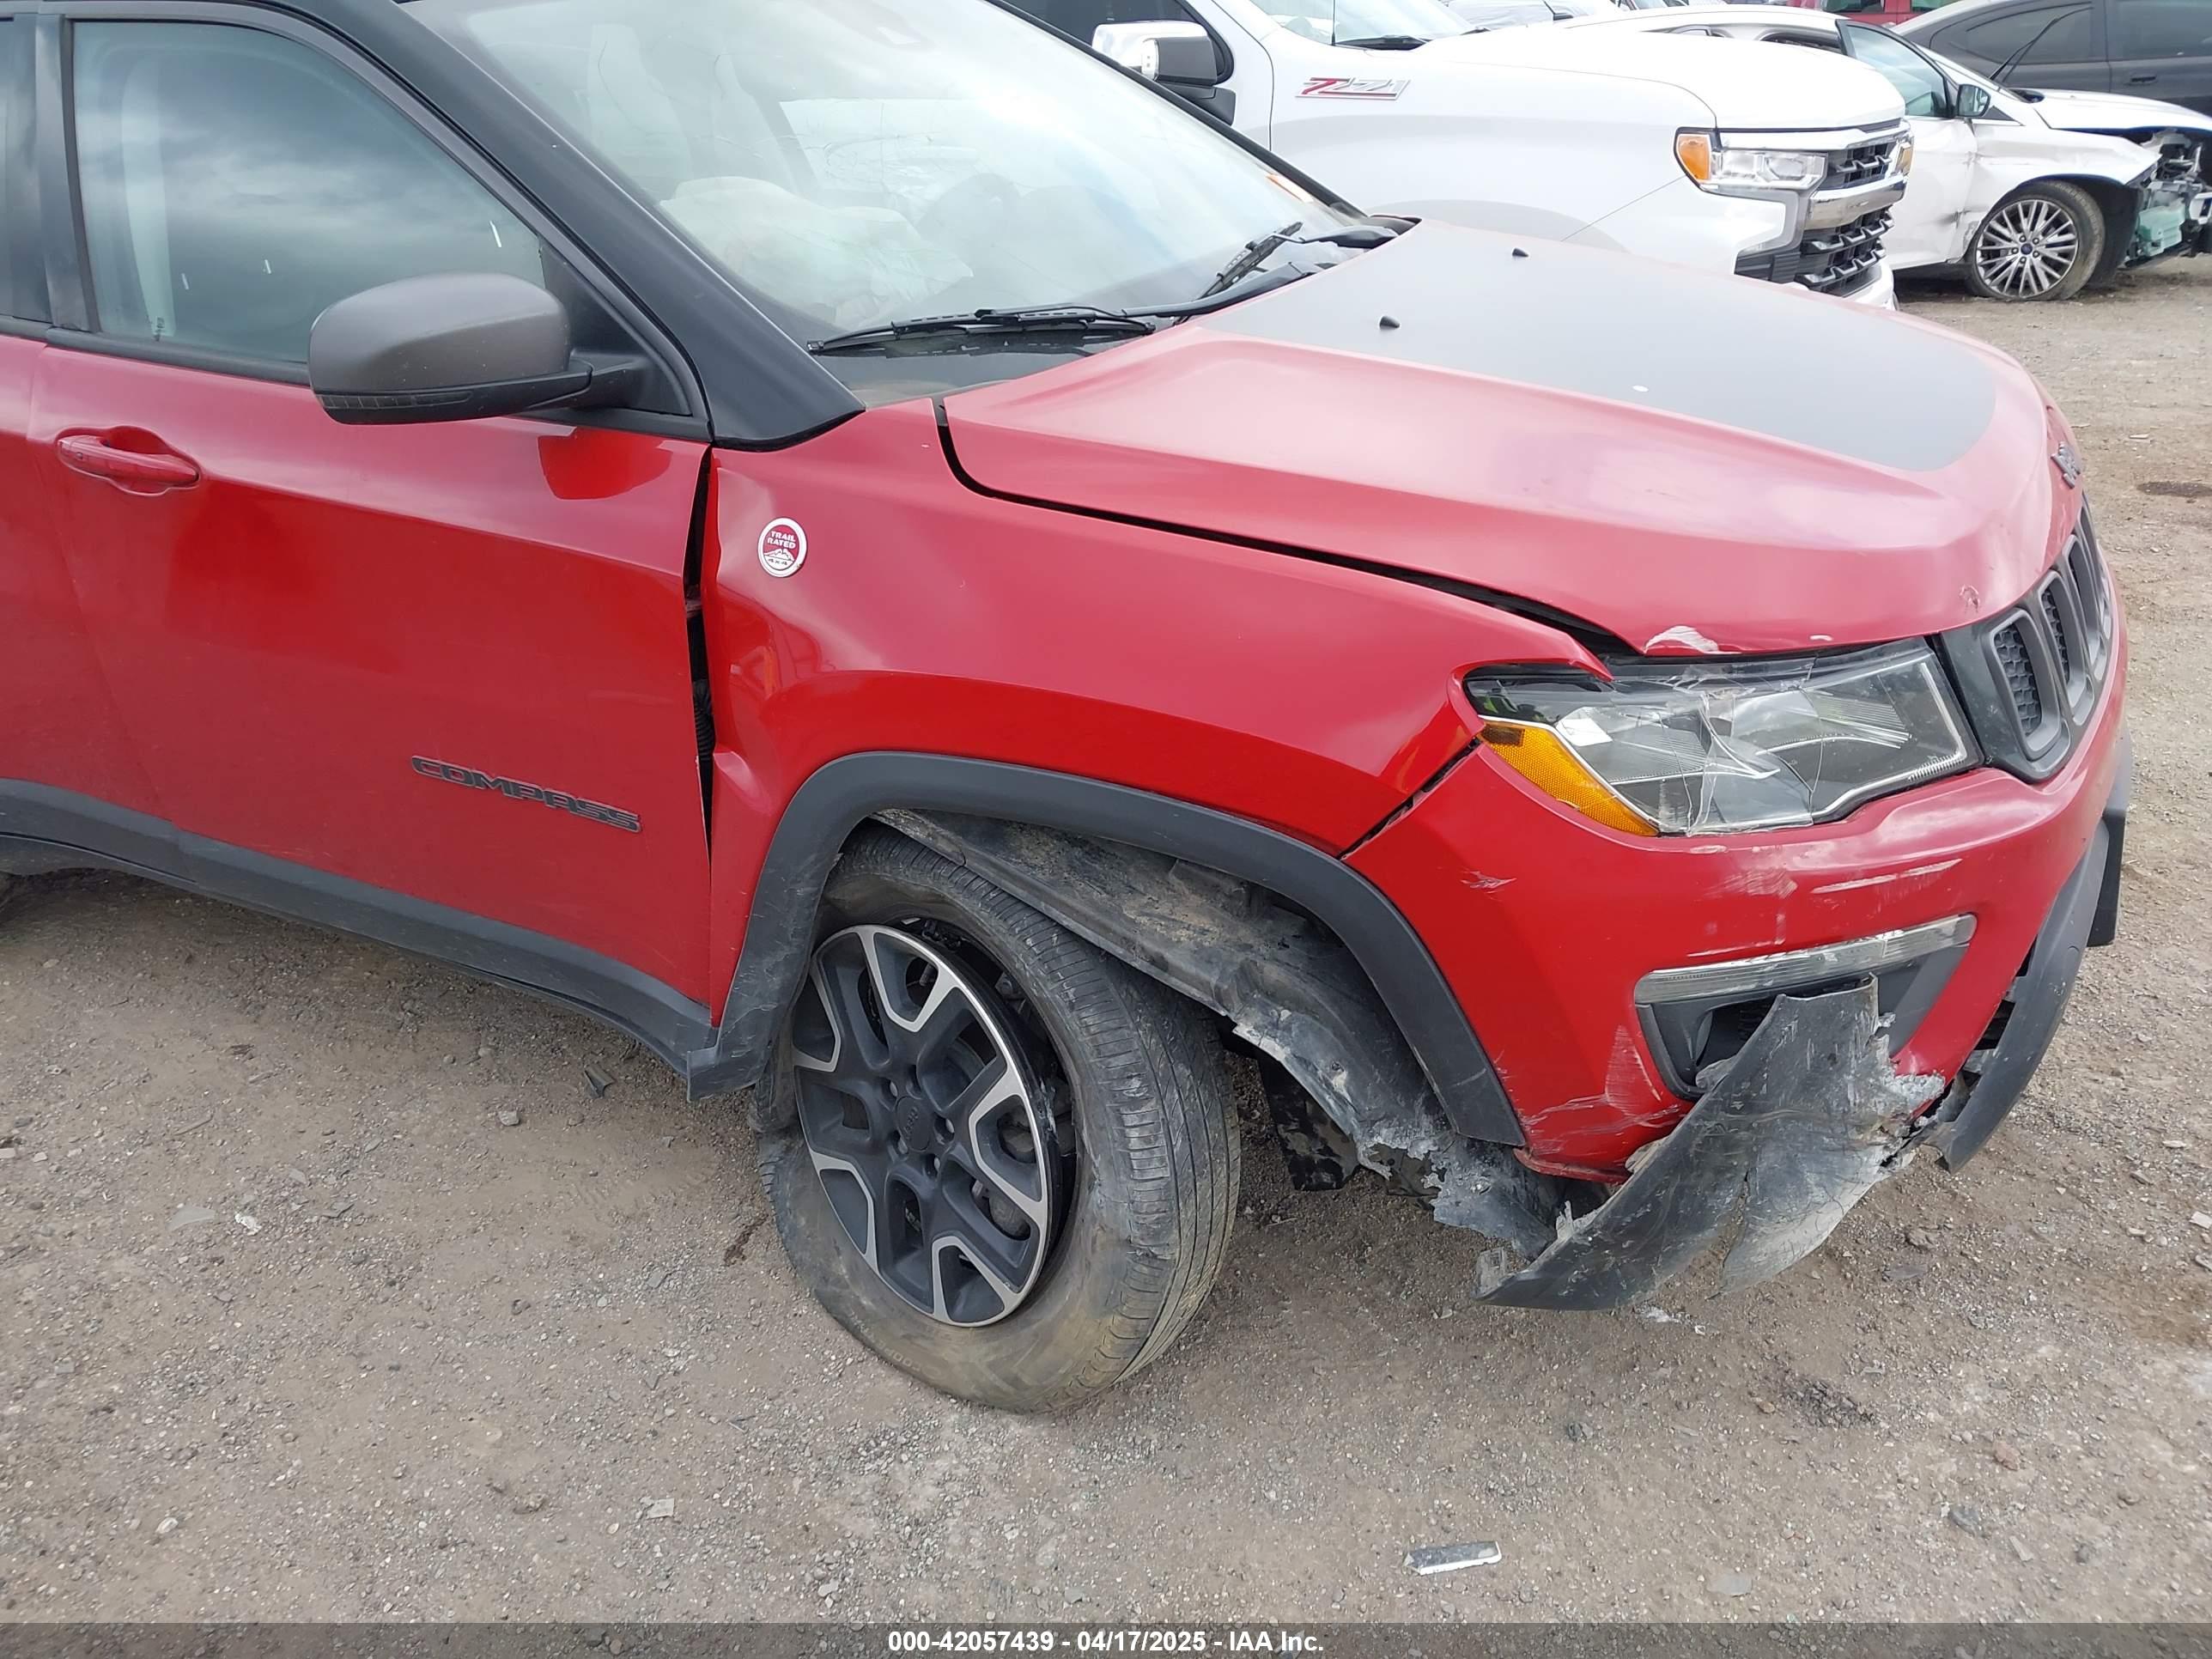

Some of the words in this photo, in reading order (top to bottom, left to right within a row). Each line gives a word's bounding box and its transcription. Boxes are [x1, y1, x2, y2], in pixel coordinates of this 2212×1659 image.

[1297, 76, 1410, 100] Z71
[767, 537, 796, 550] RATED
[771, 531, 796, 542] TRAIL
[411, 755, 641, 833] COMPASS
